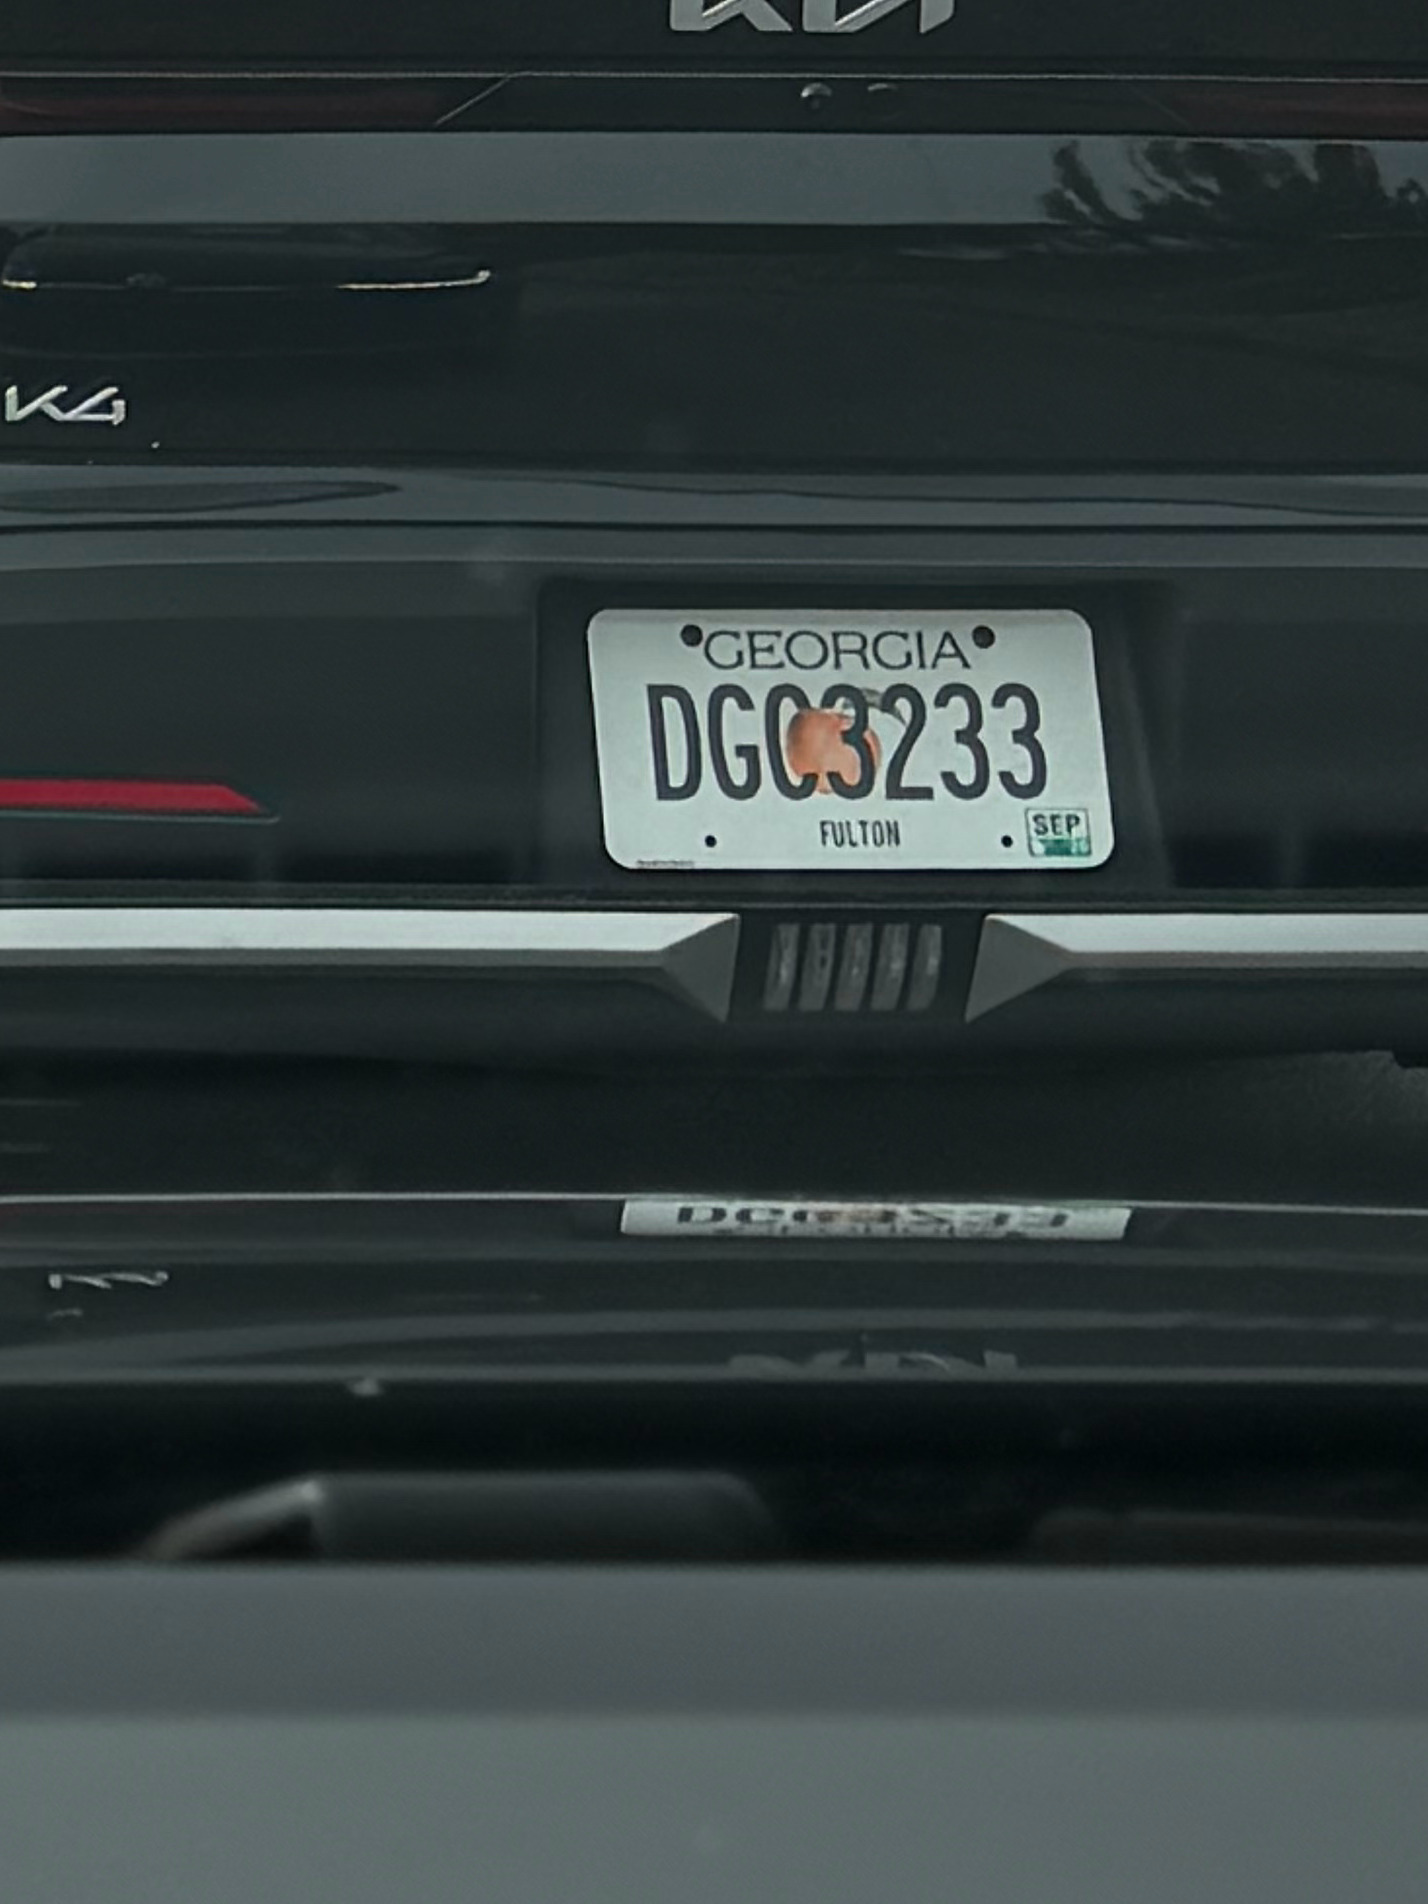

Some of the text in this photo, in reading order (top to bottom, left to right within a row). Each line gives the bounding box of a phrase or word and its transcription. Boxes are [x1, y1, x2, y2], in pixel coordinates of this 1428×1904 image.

[3, 382, 126, 427] K4
[703, 628, 972, 672] GEORGIA
[645, 682, 1049, 803] DGC3233
[819, 819, 902, 849] FULTON
[1032, 813, 1081, 837] SEP
